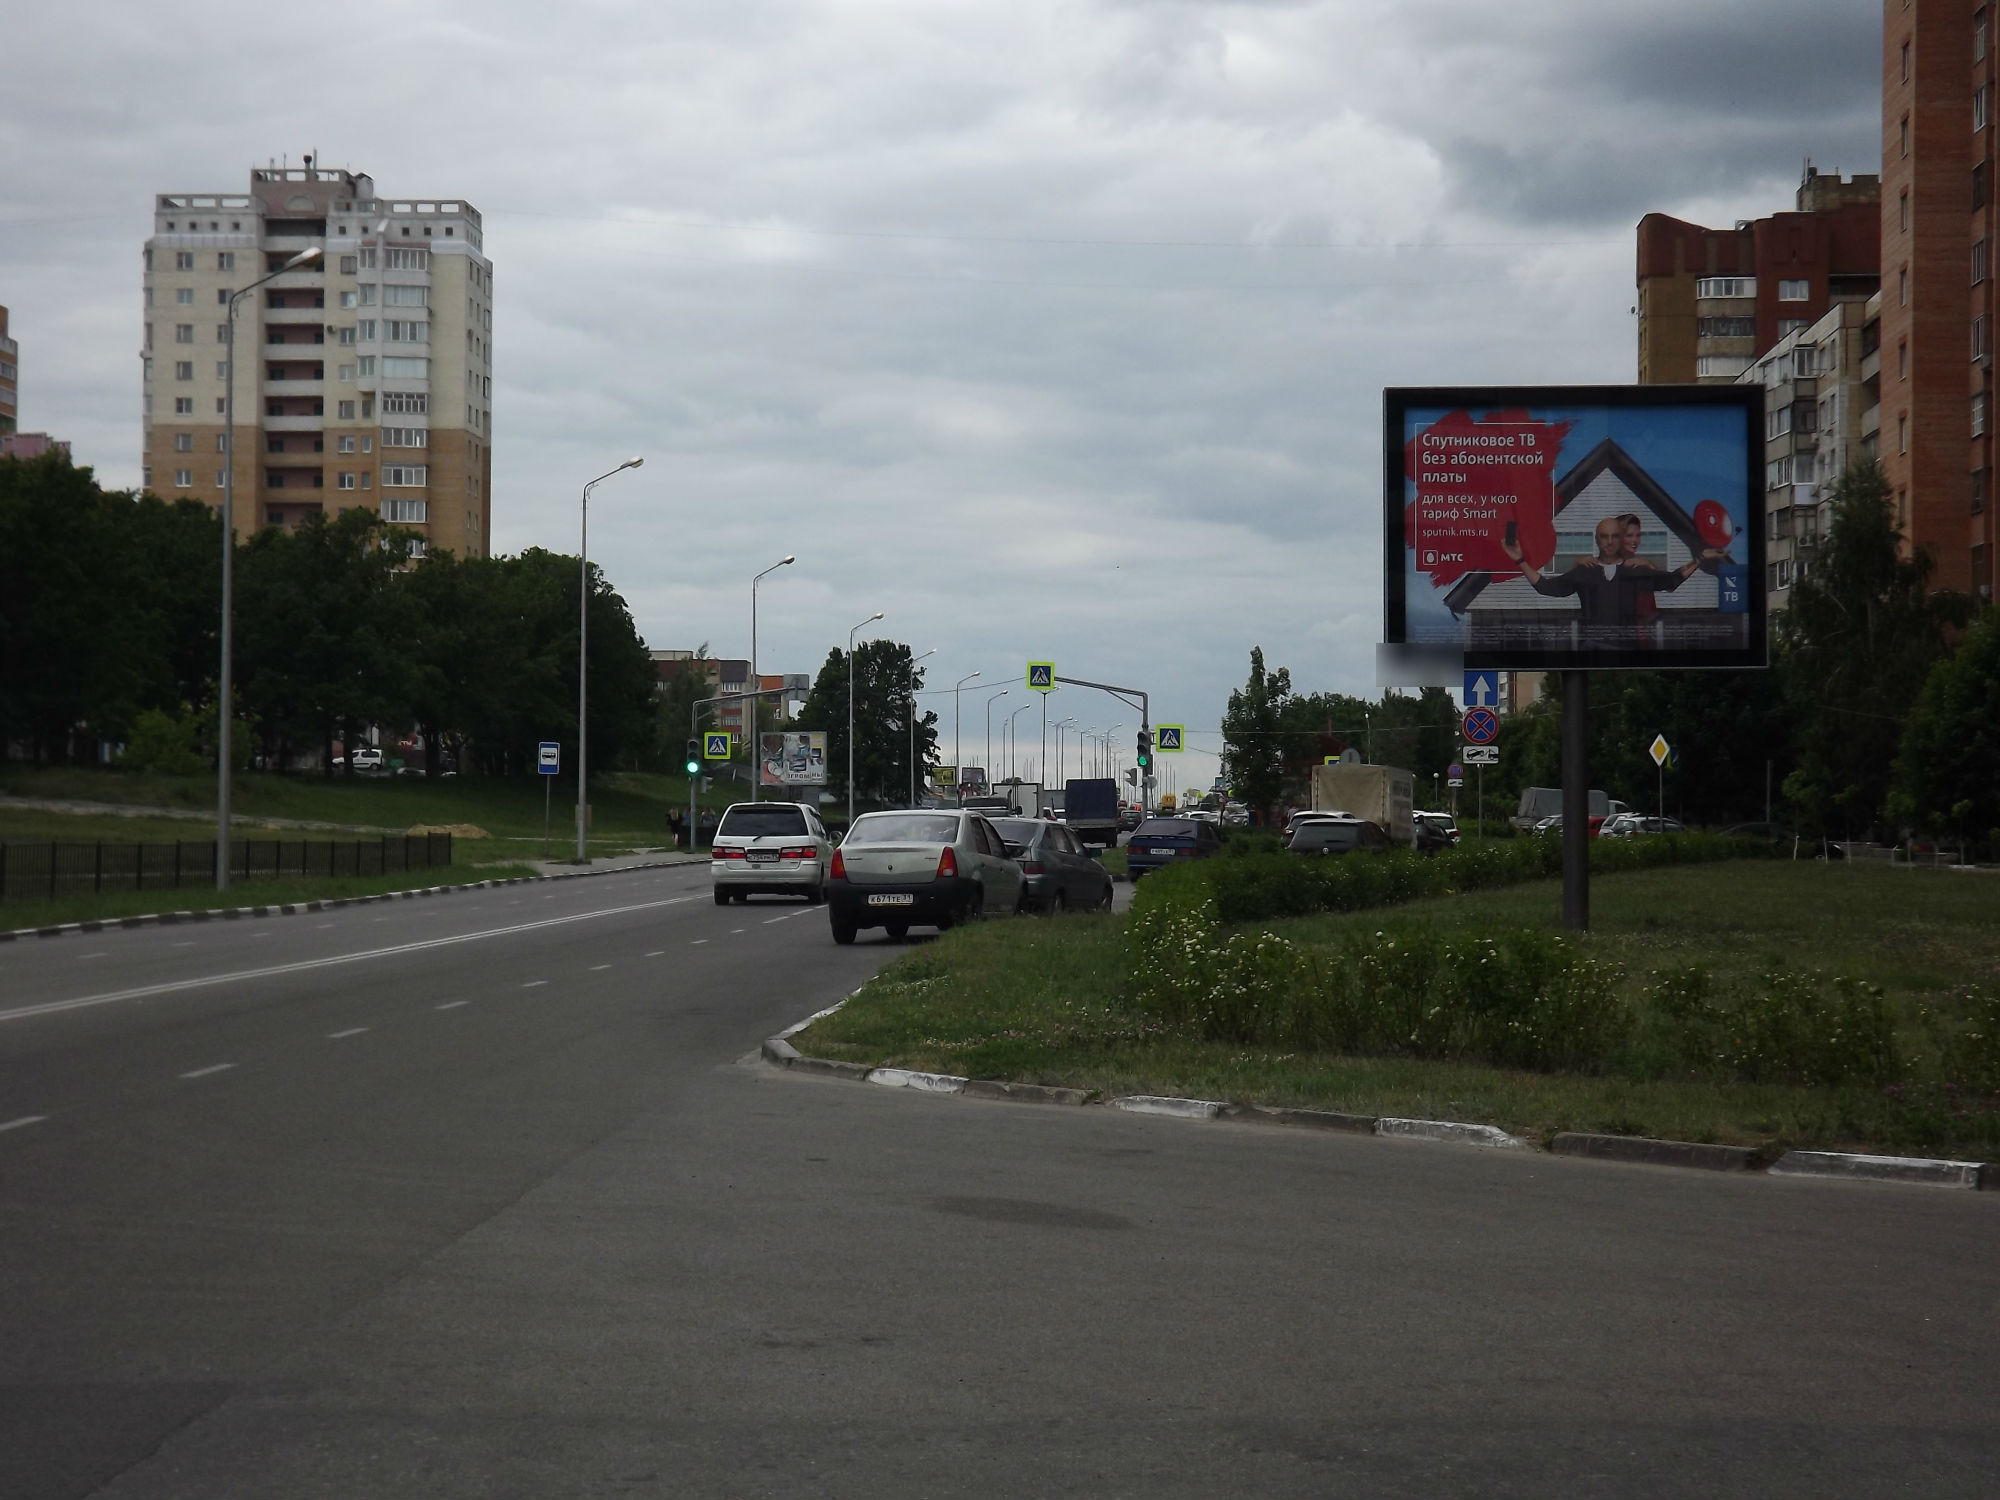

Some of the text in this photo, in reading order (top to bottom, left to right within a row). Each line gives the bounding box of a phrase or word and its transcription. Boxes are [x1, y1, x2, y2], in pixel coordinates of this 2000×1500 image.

[1422, 433, 1535, 449] Спутниковое ТВ
[1422, 451, 1543, 465] без абонентской
[1422, 472, 1466, 483] платы
[1422, 494, 1517, 505] для всех, у кого
[1422, 508, 1497, 520] тариф Smart
[1422, 527, 1488, 537] sputnik.mts.ru
[1724, 592, 1738, 602] ТВ
